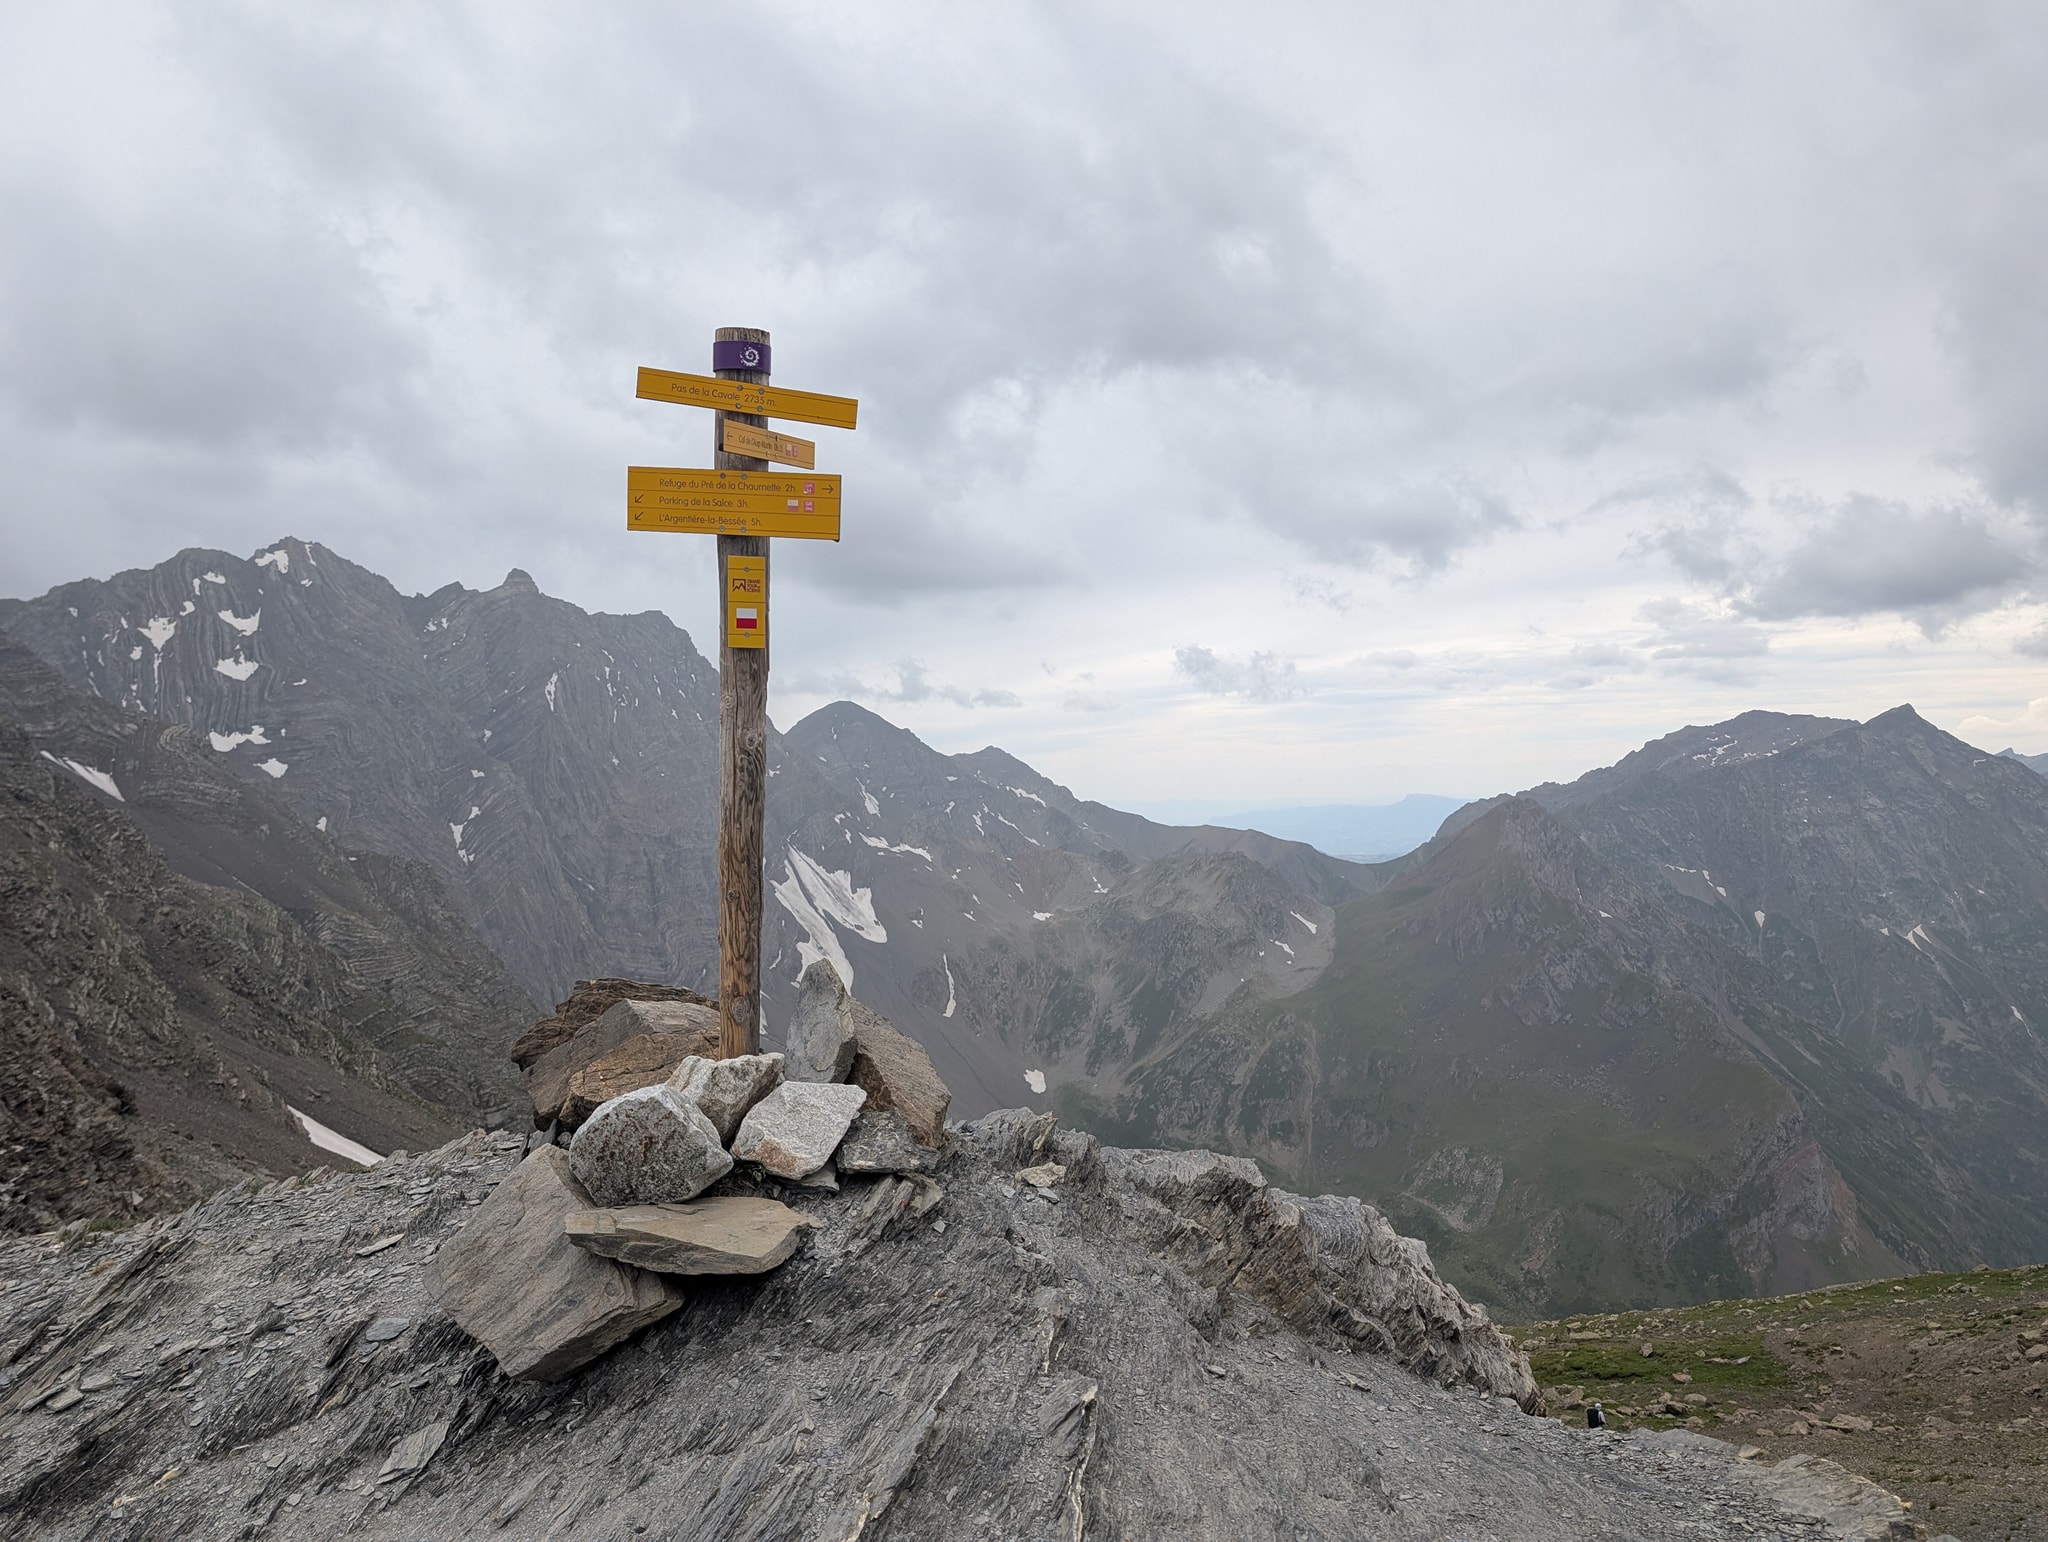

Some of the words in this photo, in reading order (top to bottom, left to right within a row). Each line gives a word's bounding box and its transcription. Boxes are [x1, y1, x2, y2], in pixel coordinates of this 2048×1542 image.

[671, 383, 687, 393] Pas
[689, 386, 700, 395] de
[702, 387, 710, 397] la
[711, 389, 740, 401] Cavale
[744, 394, 765, 405] 2735
[659, 478, 687, 489] Refuge
[688, 480, 699, 488] du
[701, 480, 714, 489] Pré
[715, 481, 727, 489] de
[728, 482, 736, 490] la
[737, 481, 781, 492] Chaumette
[659, 495, 689, 507] Parking
[690, 497, 701, 506] de
[702, 498, 711, 506] la
[712, 498, 733, 507] Salce
